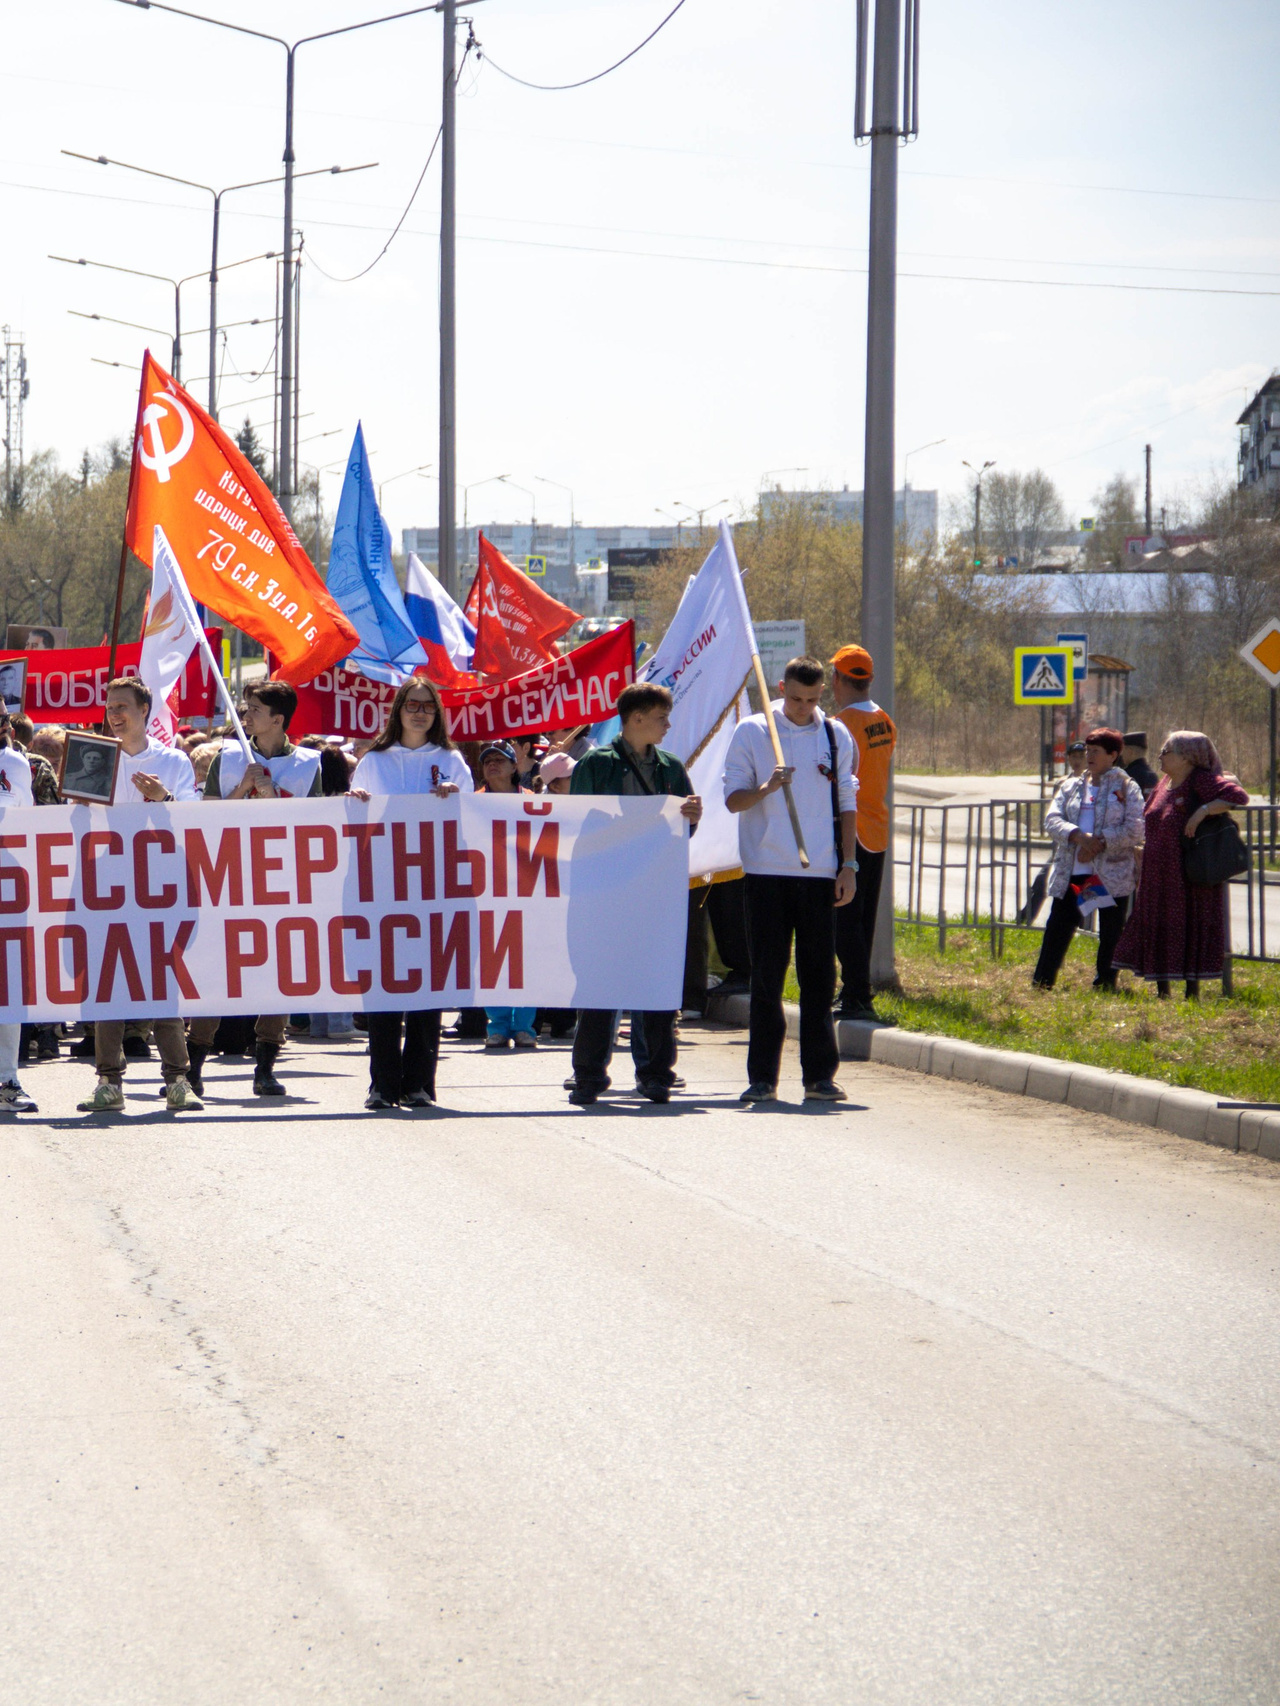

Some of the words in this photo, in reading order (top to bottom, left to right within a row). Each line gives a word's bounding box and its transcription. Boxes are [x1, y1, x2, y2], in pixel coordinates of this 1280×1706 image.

[196, 529, 237, 571] 79
[246, 528, 277, 557] ДИВ.
[224, 910, 525, 999] РОССИИ
